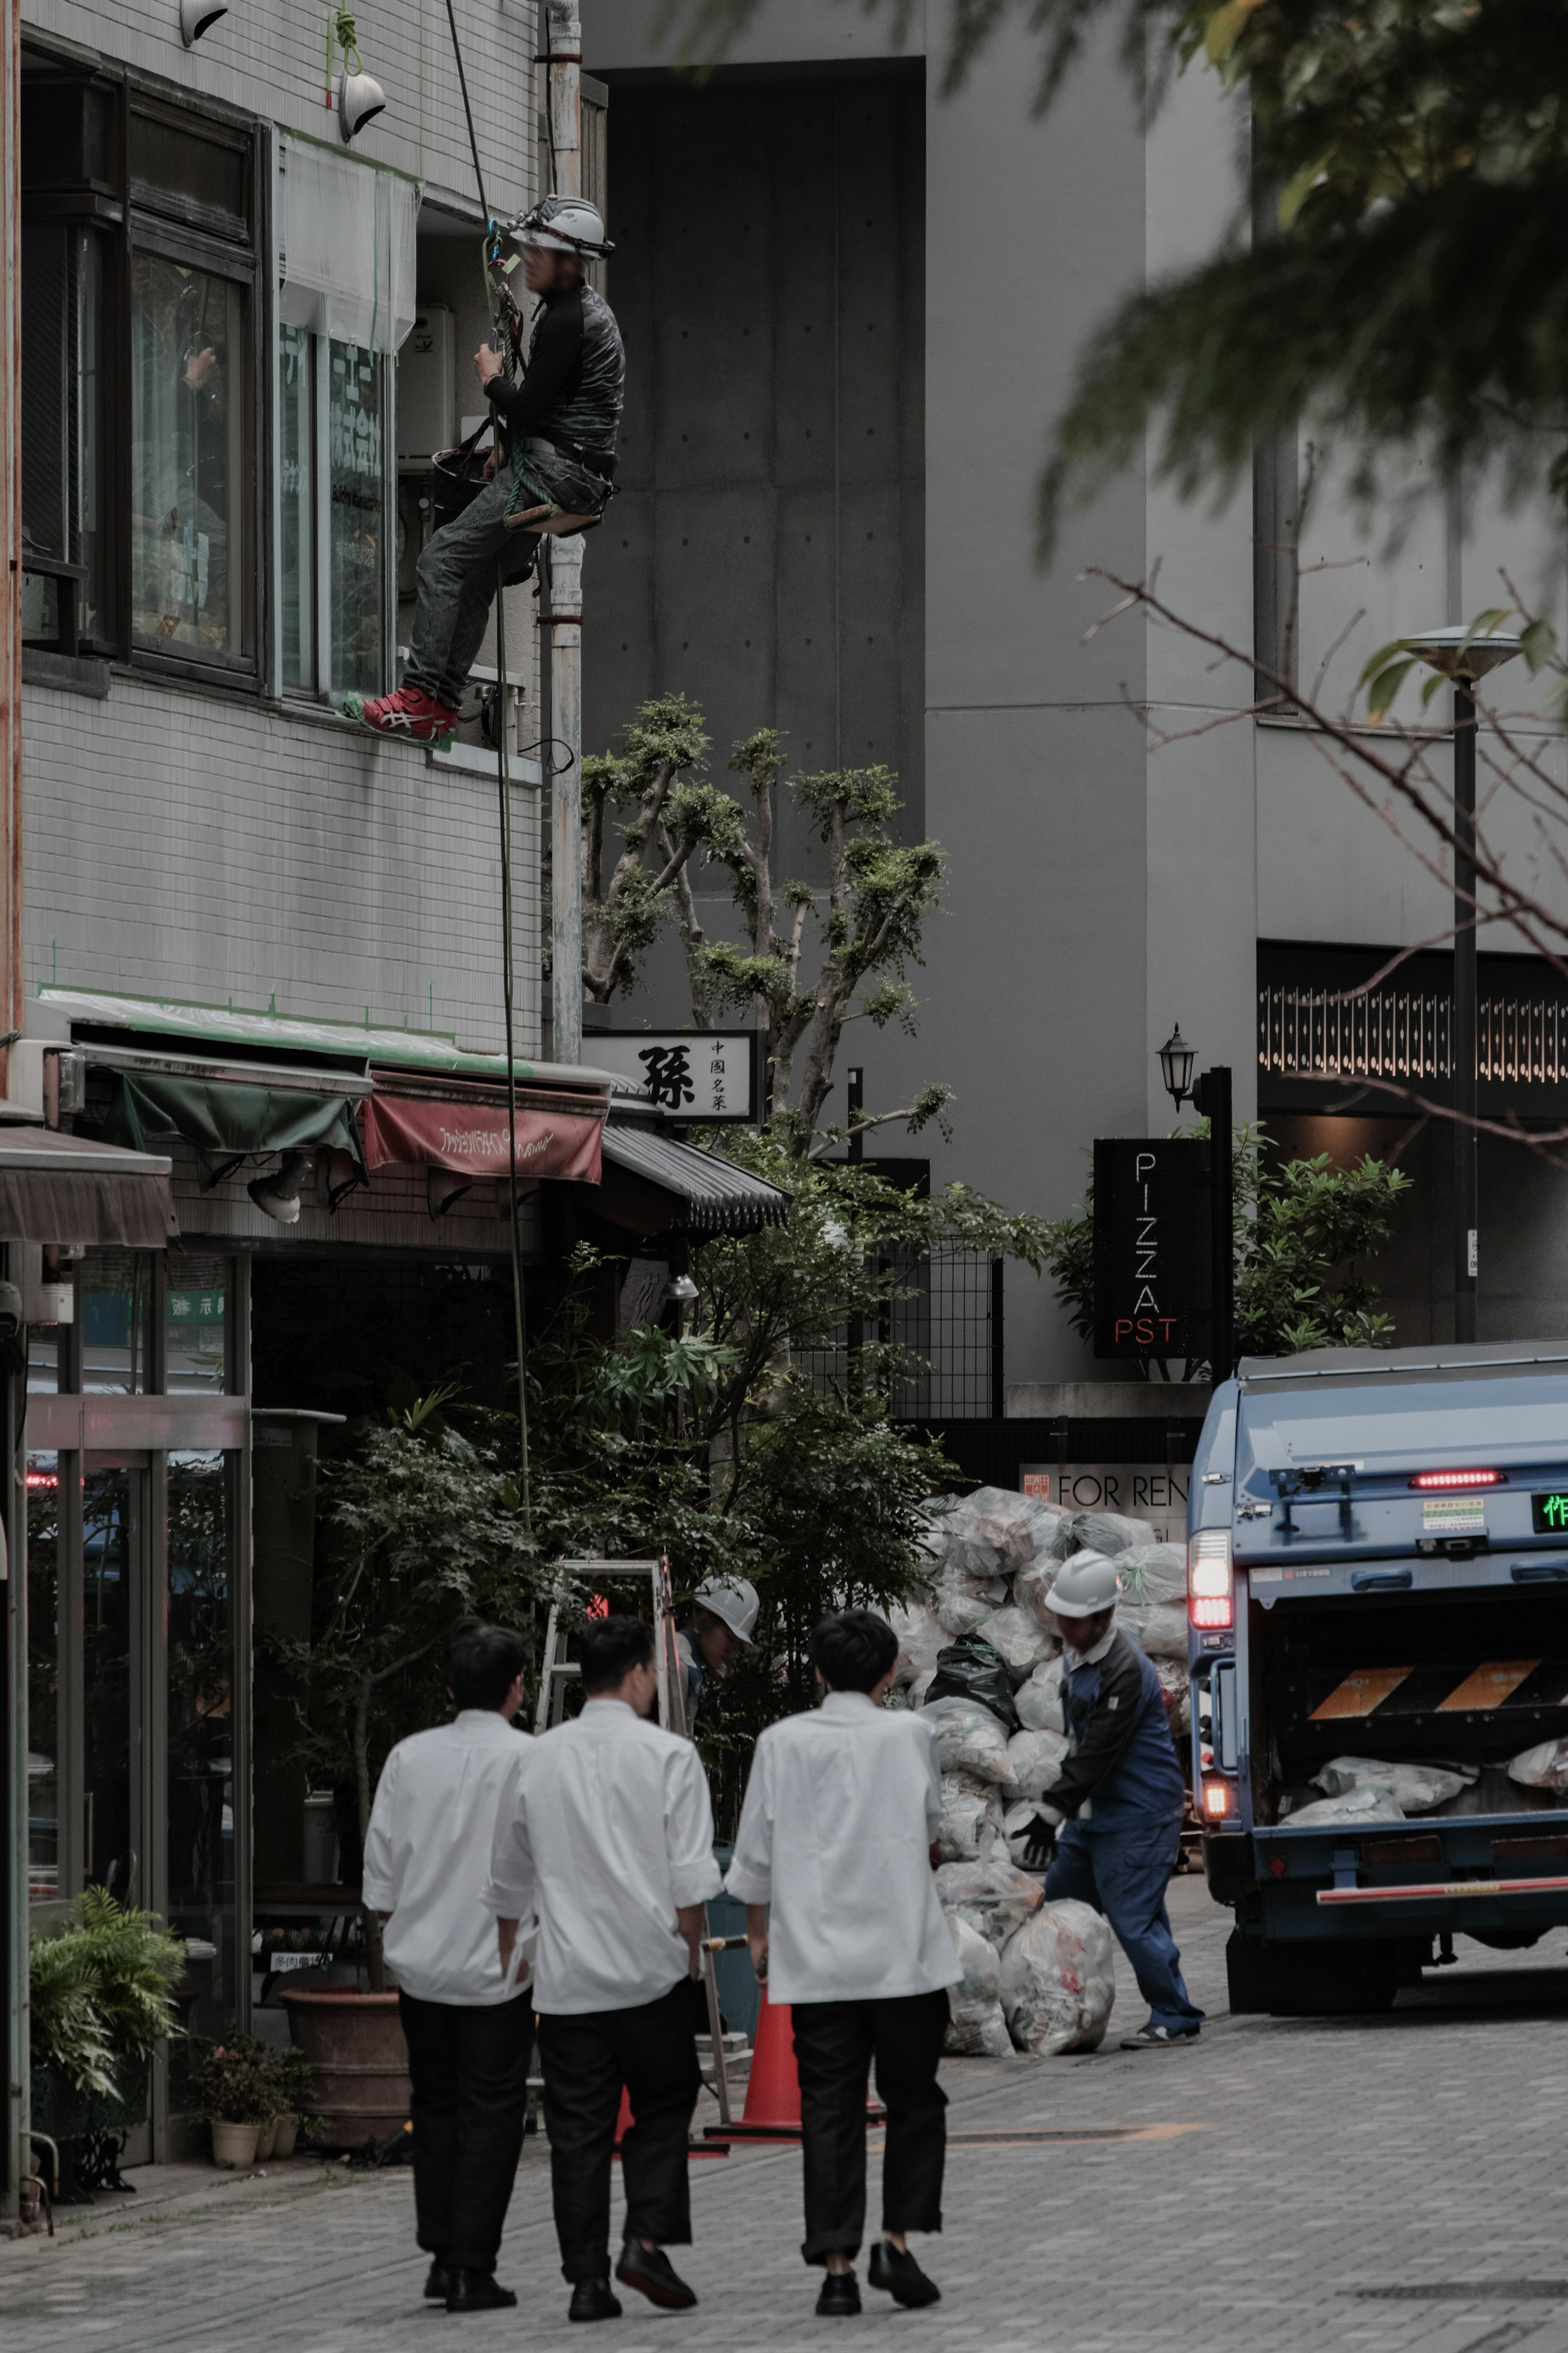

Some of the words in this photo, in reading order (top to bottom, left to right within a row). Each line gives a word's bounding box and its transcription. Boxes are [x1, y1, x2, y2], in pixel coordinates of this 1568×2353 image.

[330, 401, 381, 477] 株式会社
[333, 484, 352, 507] Building
[638, 1046, 695, 1110] 孫
[710, 1041, 727, 1111] 中國名菜
[1134, 1153, 1159, 1315] PIZZA
[1115, 1318, 1178, 1344] PST
[1059, 1475, 1120, 1506] FOR
[1134, 1476, 1189, 1506] REN
